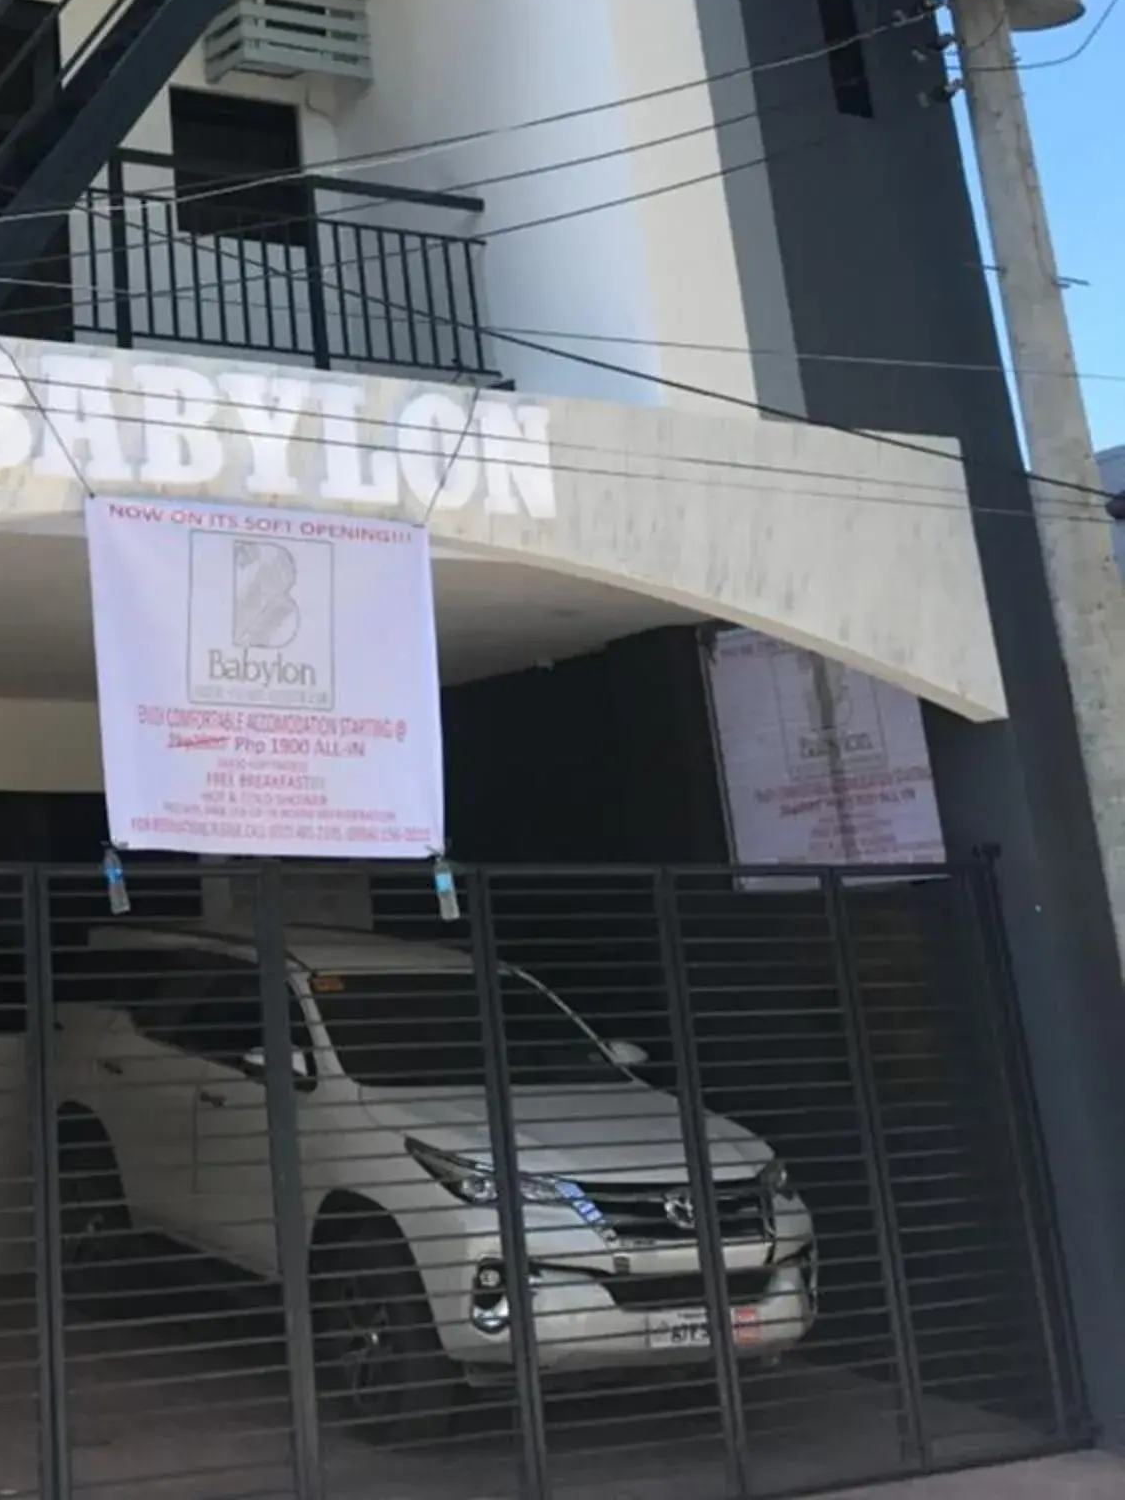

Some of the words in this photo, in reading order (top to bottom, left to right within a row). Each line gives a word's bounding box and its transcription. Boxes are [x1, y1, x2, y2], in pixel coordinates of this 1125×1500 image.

[108, 504, 164, 524] NOW
[170, 509, 204, 527] ON
[208, 512, 239, 530] ITS
[245, 515, 292, 534] SOFT
[207, 648, 317, 687] Babylon
[234, 736, 266, 755] Php
